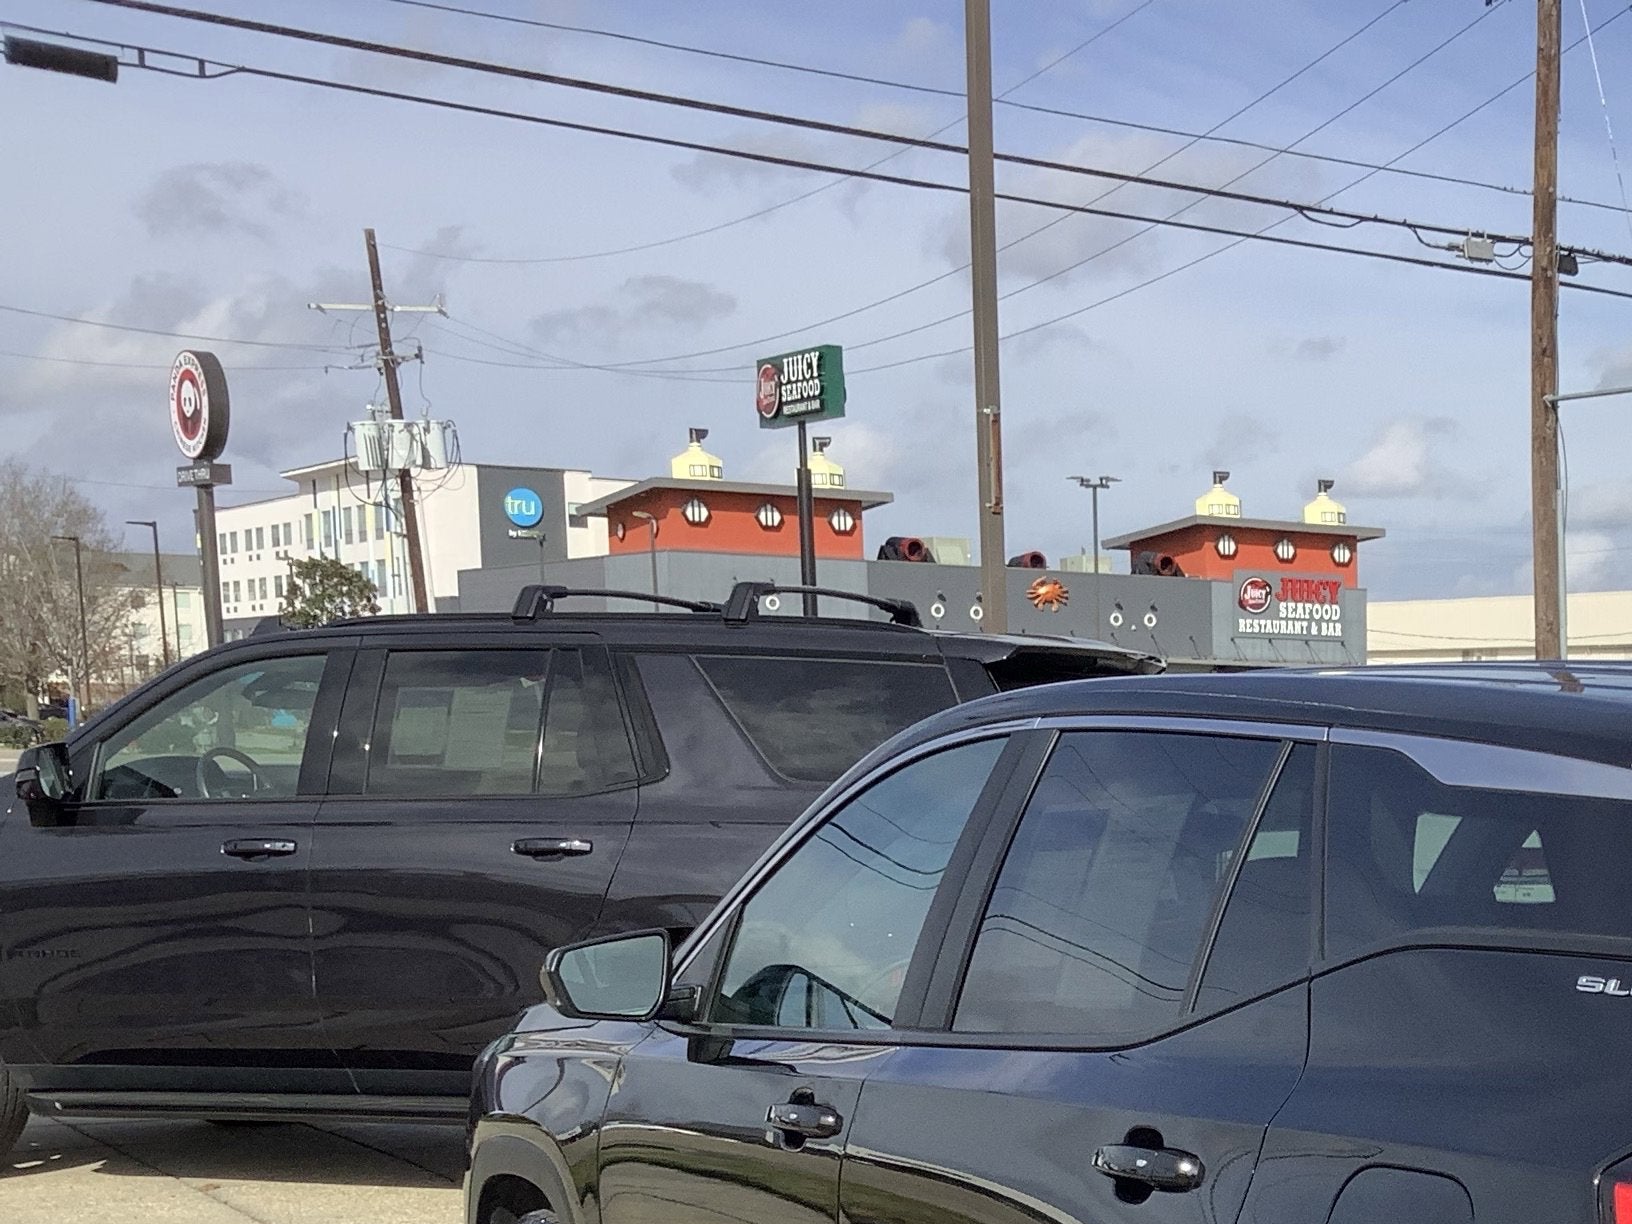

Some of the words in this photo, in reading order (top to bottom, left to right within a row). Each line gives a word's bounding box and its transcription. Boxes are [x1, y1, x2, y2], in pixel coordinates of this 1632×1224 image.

[780, 351, 819, 384] JUICY
[170, 359, 183, 401] PANDA
[781, 378, 821, 402] SEAFOOD
[505, 496, 536, 515] tru
[1275, 577, 1341, 605] JUICY
[1279, 602, 1341, 620] SEAFOOD
[1238, 618, 1308, 635] RESTAURANT
[1311, 621, 1319, 636] &
[1321, 622, 1342, 637] BAR
